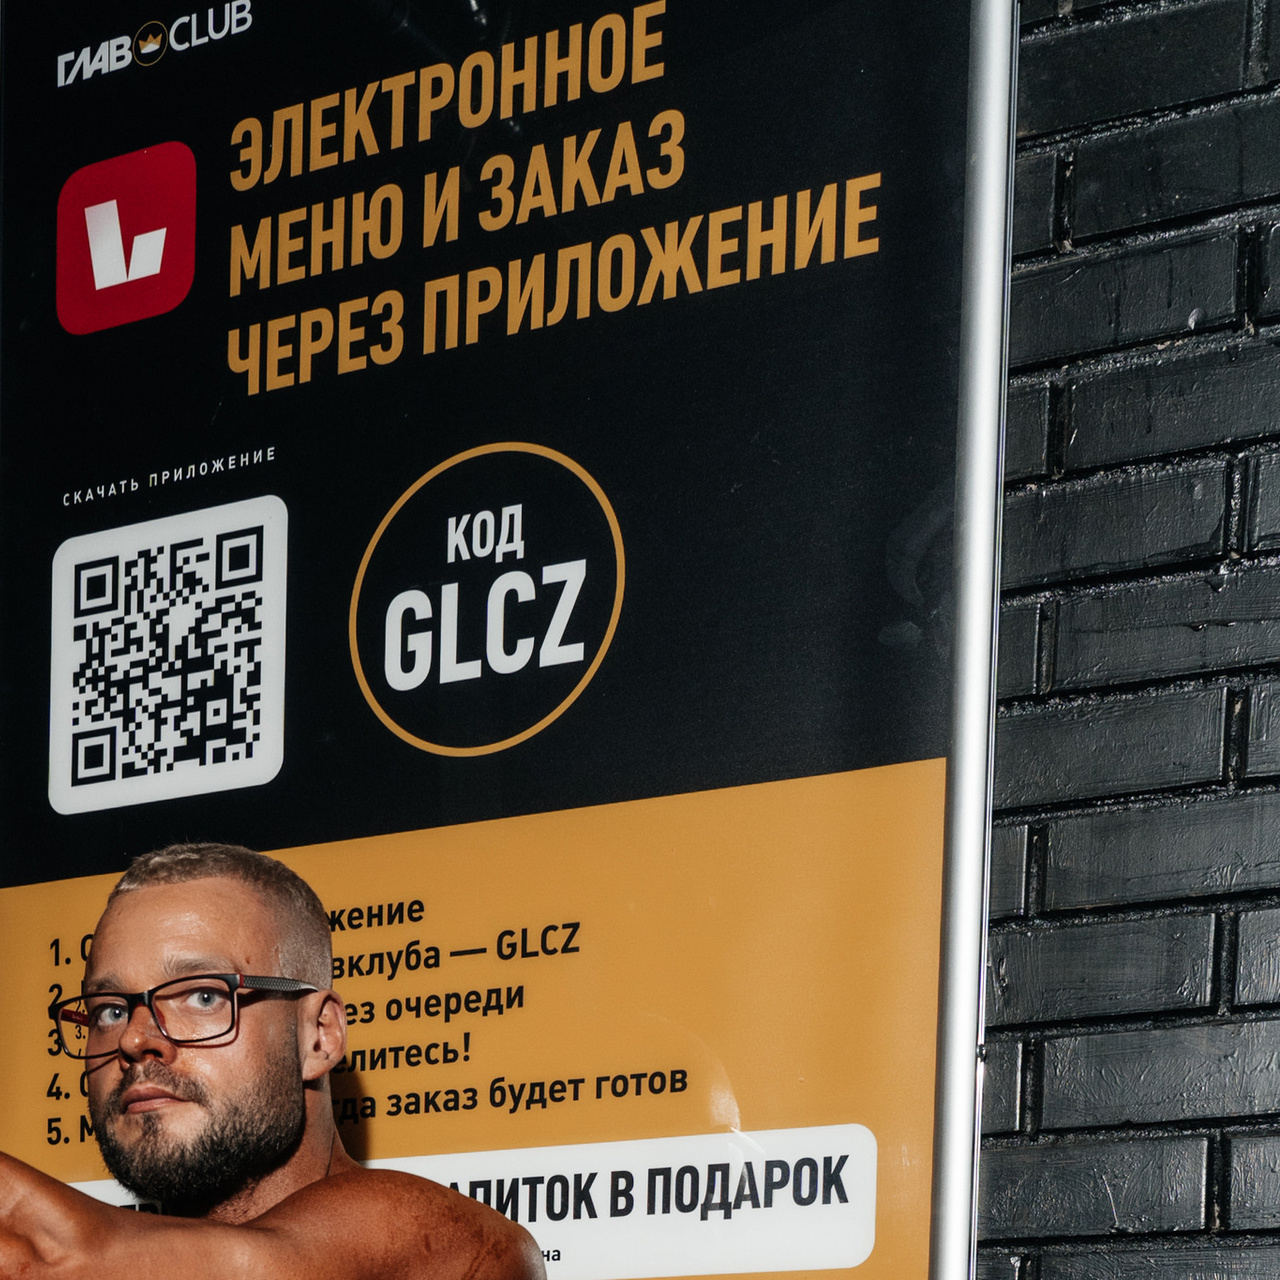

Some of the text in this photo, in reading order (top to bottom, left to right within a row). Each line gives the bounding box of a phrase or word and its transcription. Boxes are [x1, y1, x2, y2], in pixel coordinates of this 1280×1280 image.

[57, 0, 253, 88] ГЛАВ CLUB
[230, 0, 666, 192] ЭЛЕКТРОННОЕ
[229, 109, 687, 297] МЕНЮ И ЗАКАЗ
[226, 172, 881, 396] ЧЕРЕЗ ПРИЛОЖЕНИЕ
[63, 446, 275, 507] СКАЧАТЬ ПРИЛОЖЕНИЕ
[447, 504, 525, 563] КОД
[384, 559, 587, 692] GLCZ
[49, 938, 72, 967] 1.
[324, 900, 426, 933] жение
[331, 940, 441, 981] вклуба
[496, 922, 580, 961] GLCZ
[345, 999, 376, 1026] ез
[385, 984, 525, 1023] очереди
[46, 1073, 71, 1101] 4.
[331, 1032, 471, 1074] елитесь!
[46, 1117, 71, 1145] 5.
[386, 1086, 479, 1117] заказ
[489, 1076, 585, 1114] будет
[595, 1068, 688, 1099] готов
[449, 1154, 850, 1223] ПИТОК В ПОДАРОК
